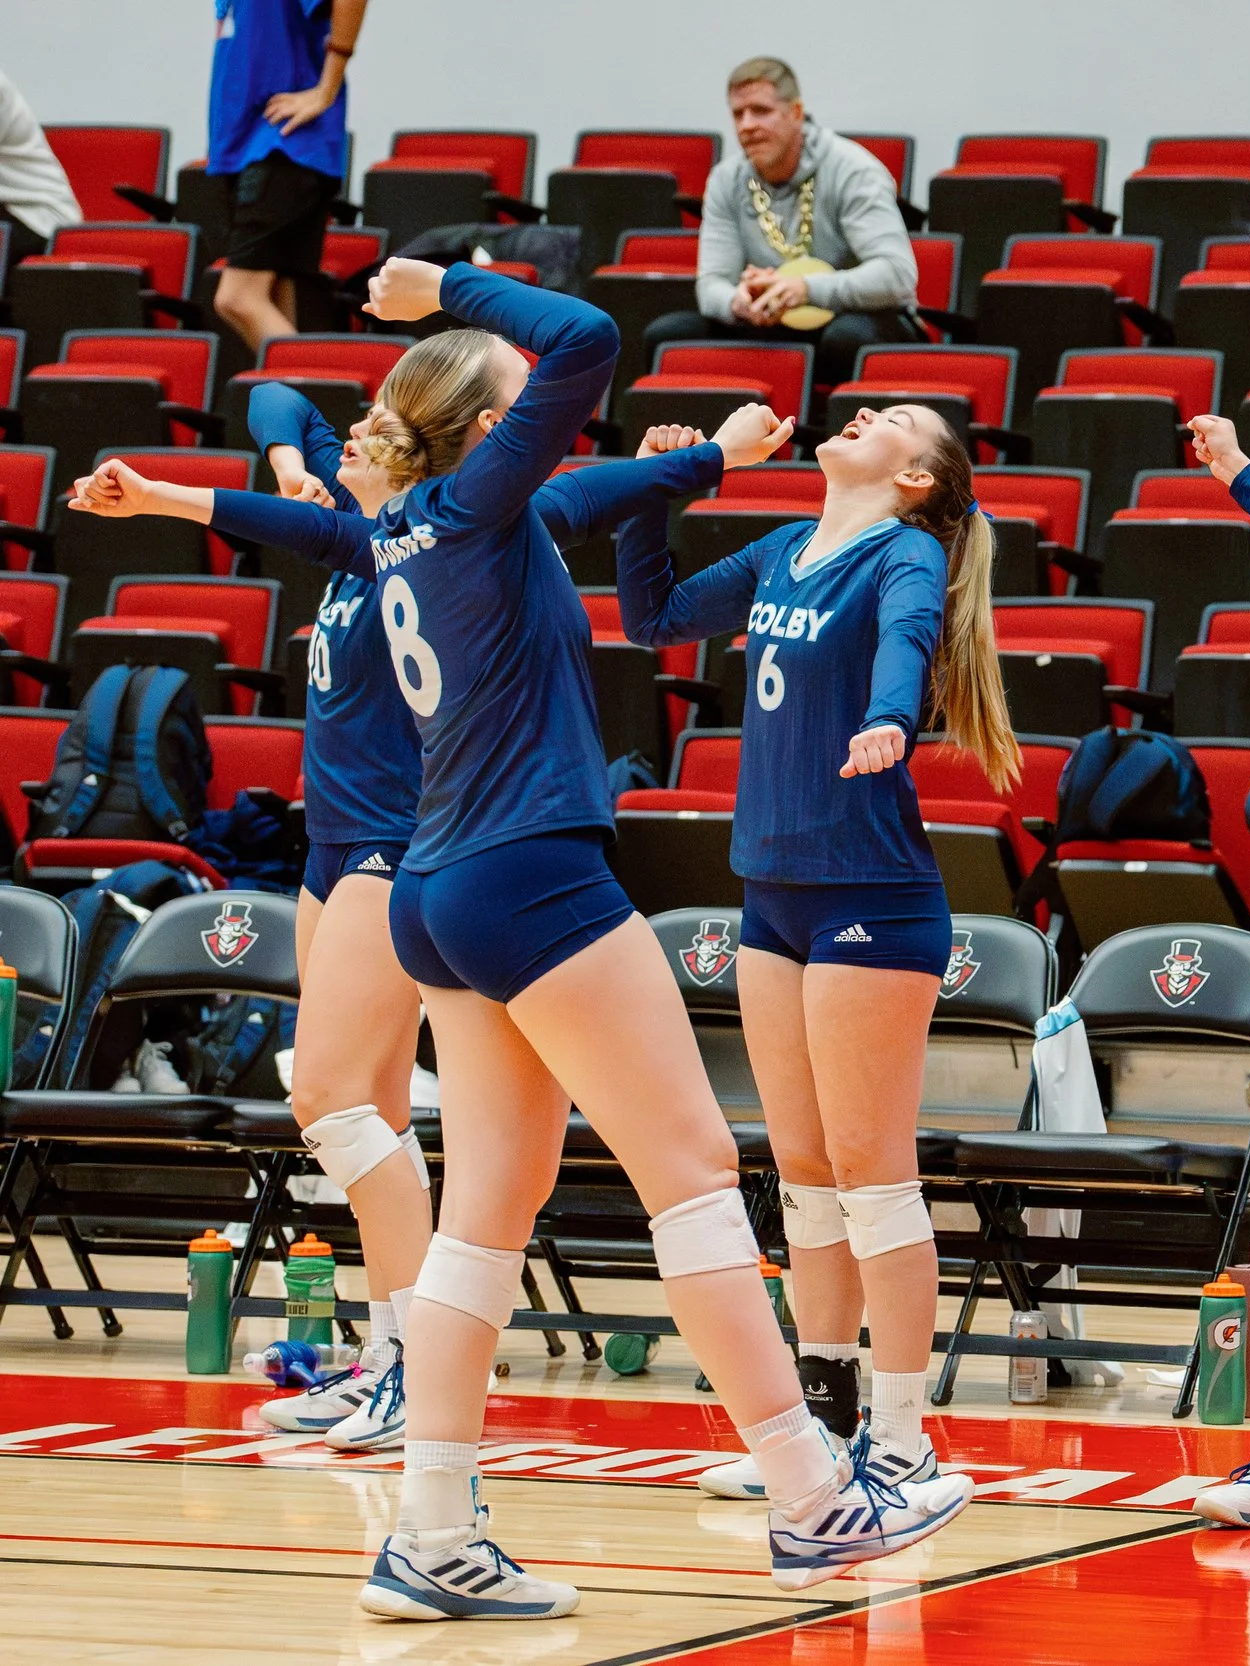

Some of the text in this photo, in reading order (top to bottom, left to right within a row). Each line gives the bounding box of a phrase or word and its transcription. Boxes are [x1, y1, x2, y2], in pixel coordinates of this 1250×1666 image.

[747, 601, 835, 642] COLBY
[307, 621, 332, 692] 10
[382, 574, 443, 718] 8
[756, 643, 785, 712] 6
[357, 863, 392, 872] adidas
[833, 934, 873, 943] adidas
[1213, 1317, 1242, 1351] G
[0, 1421, 500, 1465] LETS
